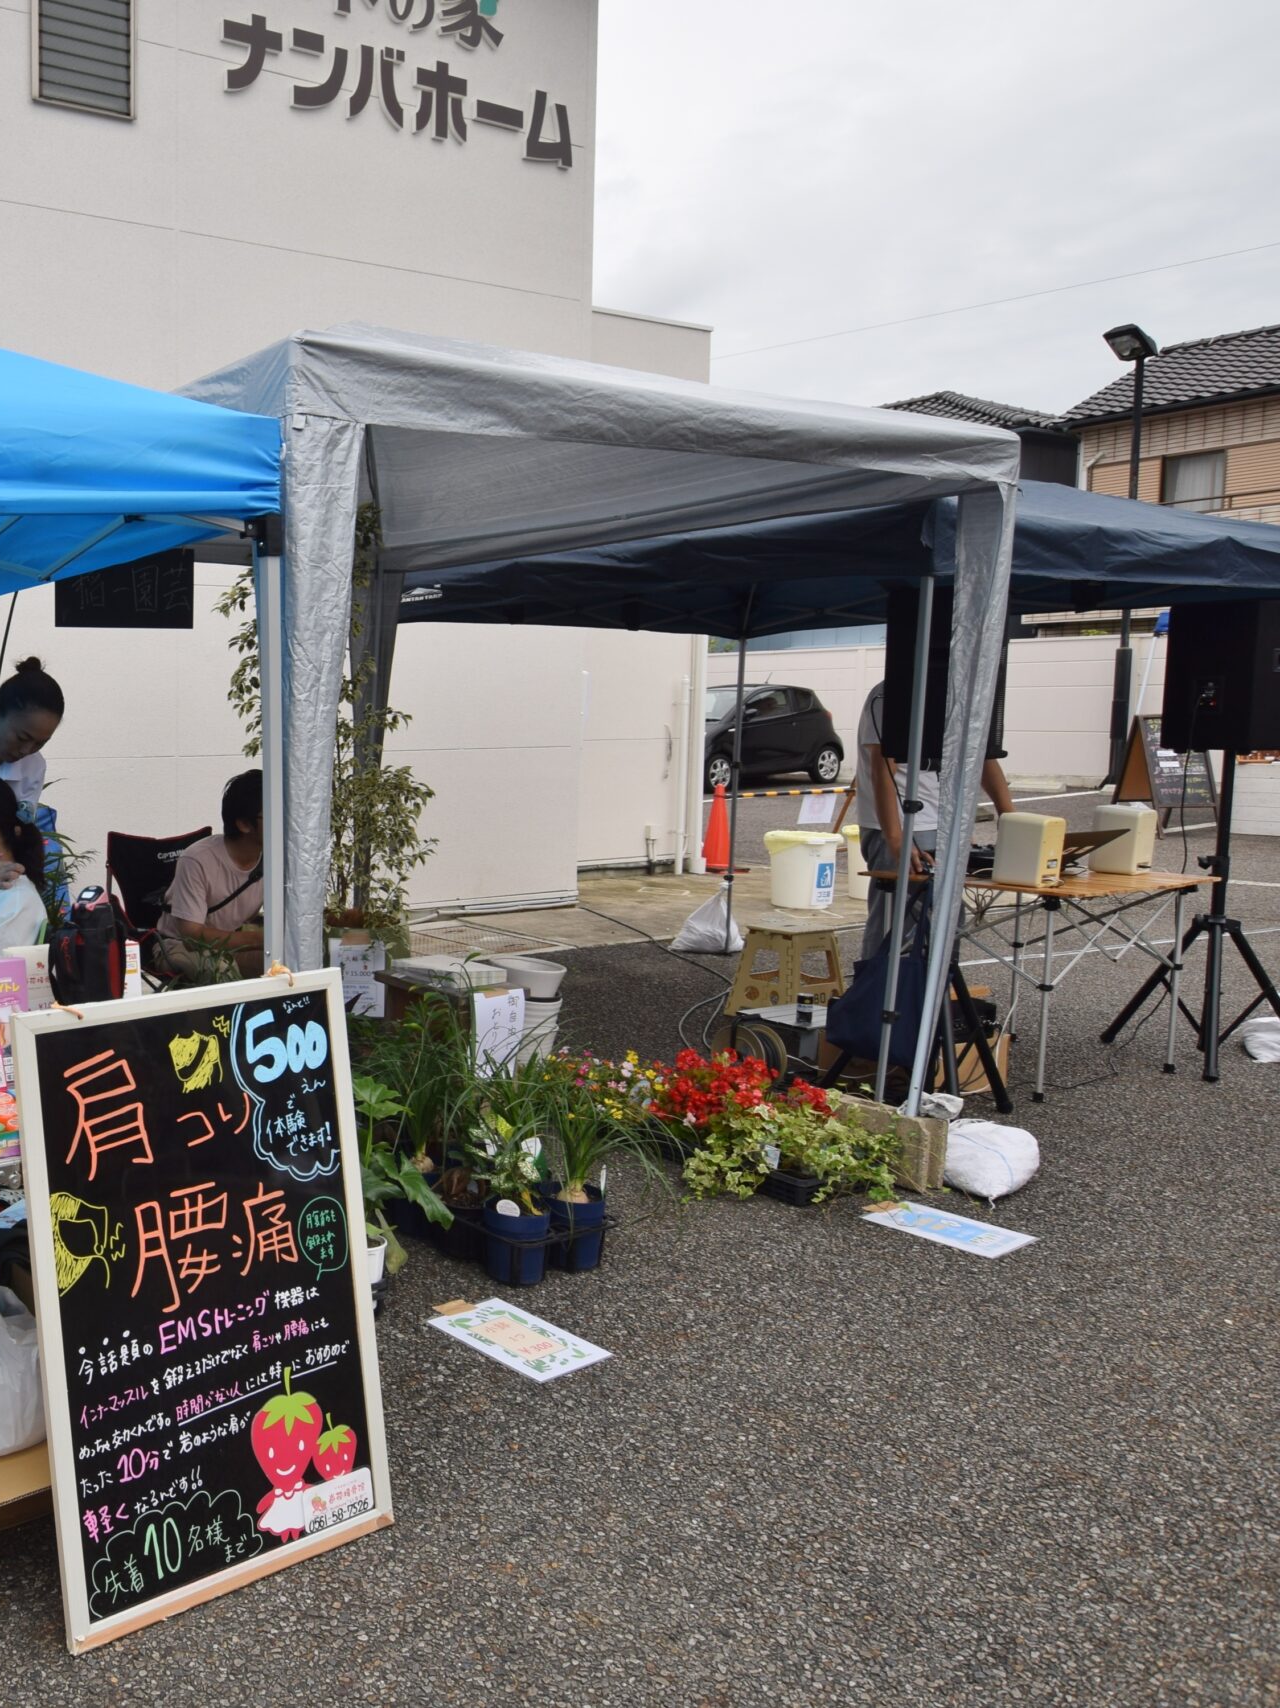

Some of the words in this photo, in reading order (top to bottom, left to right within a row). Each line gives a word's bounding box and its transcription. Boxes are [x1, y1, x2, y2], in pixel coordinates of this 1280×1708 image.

[222, 13, 573, 169] ナンバホーム
[245, 1008, 328, 1084] 500
[266, 1110, 308, 1144] 体験
[130, 1181, 299, 1313] 腰痛
